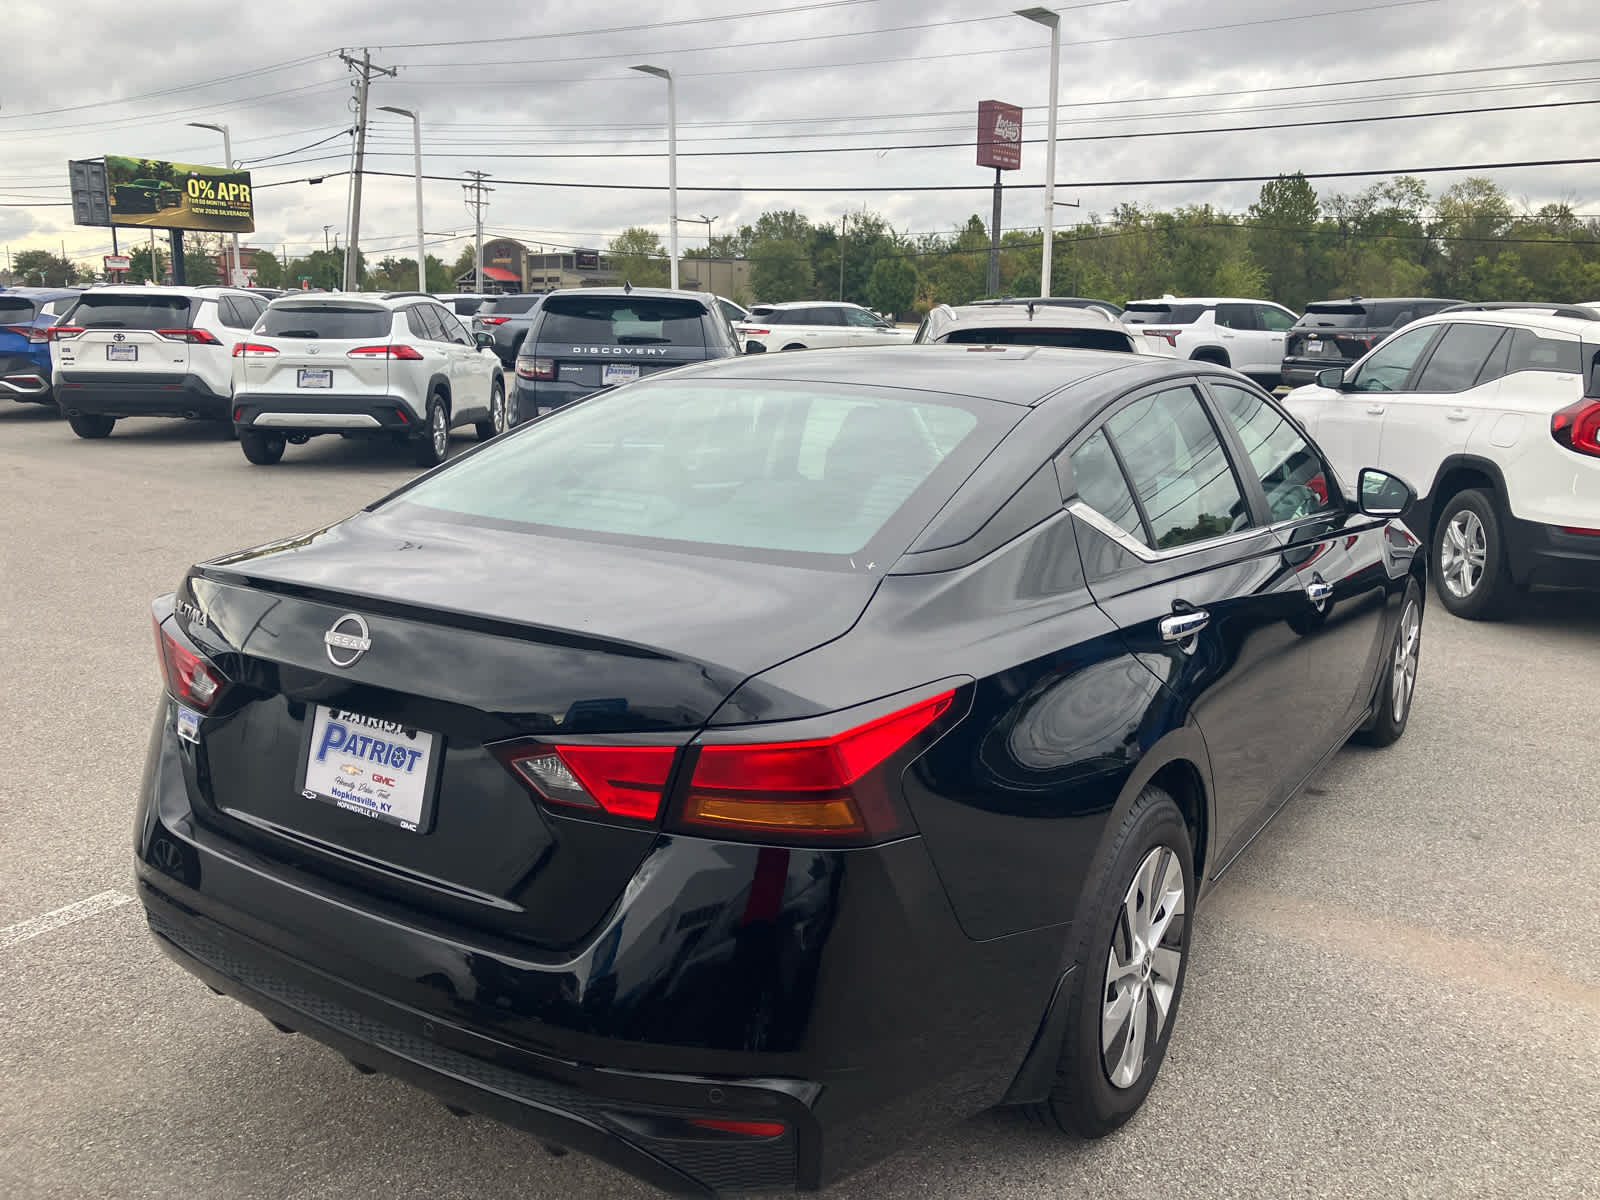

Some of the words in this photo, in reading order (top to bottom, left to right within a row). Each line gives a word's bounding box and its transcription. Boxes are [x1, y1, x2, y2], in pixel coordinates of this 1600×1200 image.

[187, 178, 215, 199] 0%
[217, 182, 251, 202] APR
[573, 347, 667, 355] DISCOVERY
[325, 632, 370, 650] NISSAN
[316, 721, 422, 772] PATRIOT
[372, 773, 396, 787] GMC
[331, 786, 379, 810] Hopkinsville,
[380, 802, 392, 813] KY
[400, 820, 417, 832] GMC
